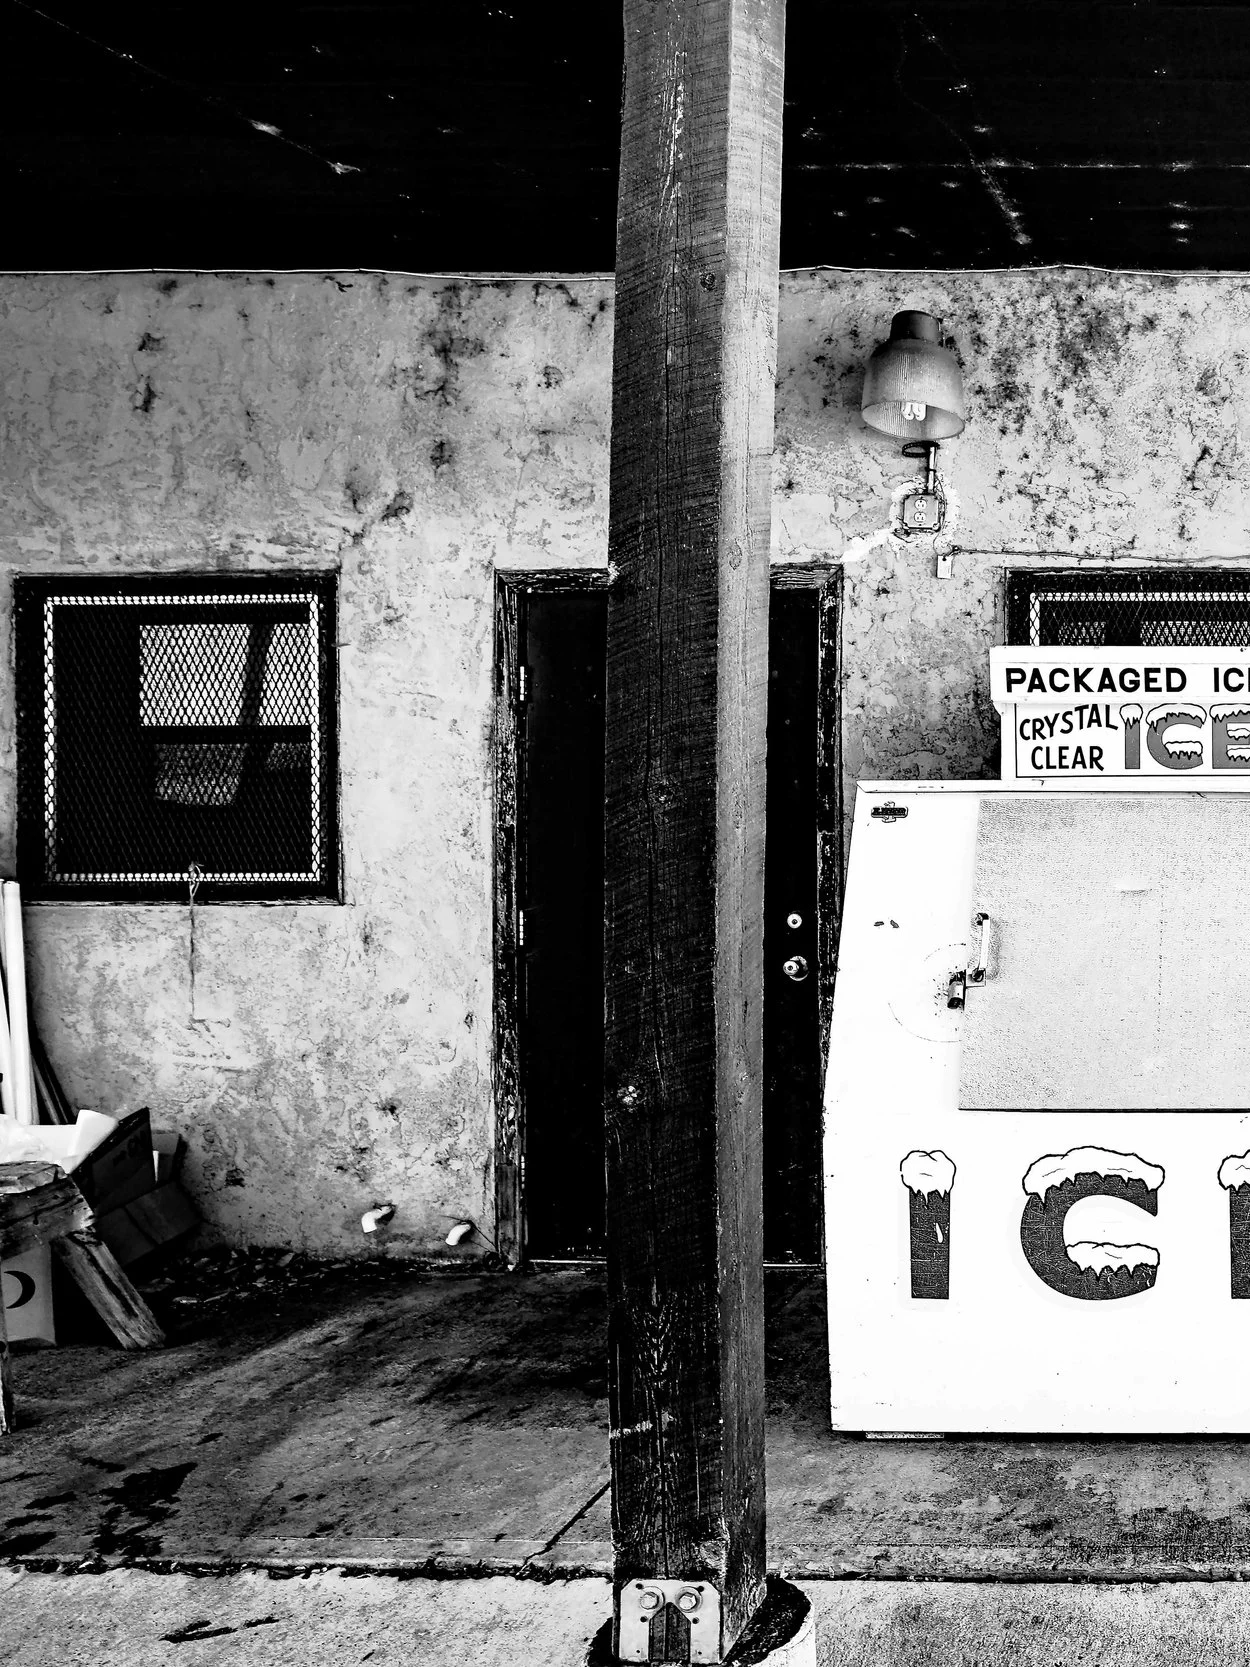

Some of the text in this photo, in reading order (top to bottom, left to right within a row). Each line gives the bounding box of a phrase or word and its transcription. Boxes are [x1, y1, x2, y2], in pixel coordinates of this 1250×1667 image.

[1005, 667, 1187, 693] PACKAGED
[1019, 704, 1119, 741] CRYSTAL
[1031, 746, 1104, 772] CLEAR
